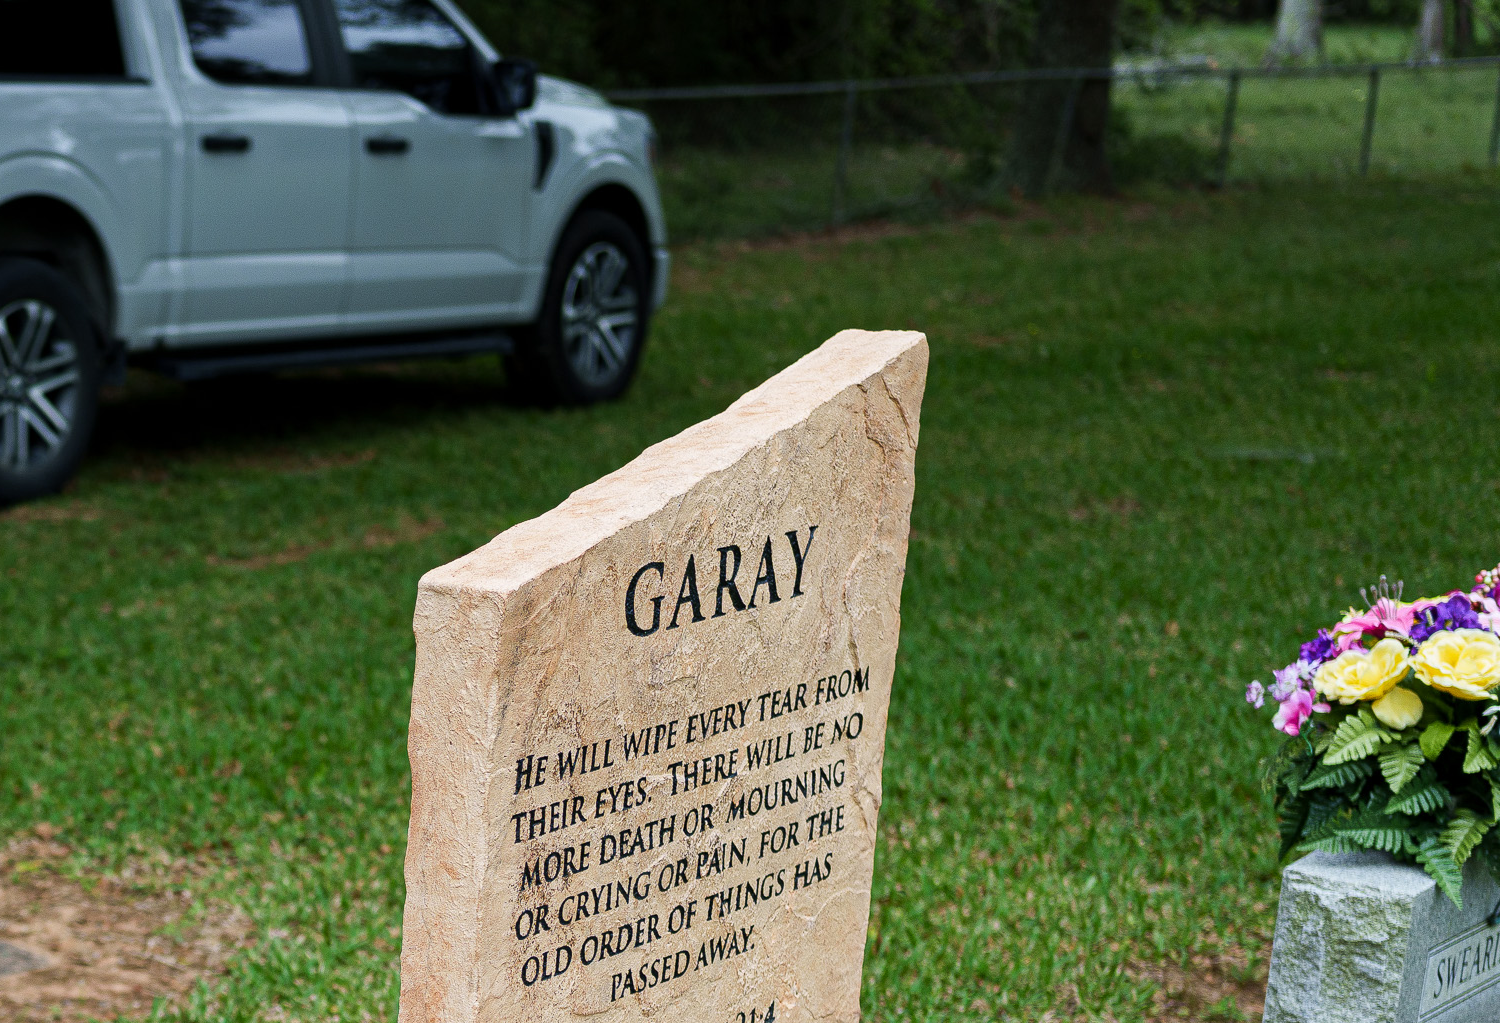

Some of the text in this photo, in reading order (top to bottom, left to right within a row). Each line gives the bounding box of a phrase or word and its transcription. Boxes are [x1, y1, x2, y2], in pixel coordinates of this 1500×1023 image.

[624, 526, 819, 637] GARAY
[510, 712, 864, 844] THEIR EYES. THERE WILL BE NO
[513, 665, 870, 796] HE WILL WIPE EVERY TEAR FROM
[514, 804, 845, 941] OR CRYING OR PAIN, FOR THE
[518, 759, 845, 892] MORE DEATH OR MOURNING
[520, 852, 833, 987] OLD ORDER OF THINGS HAS
[610, 924, 755, 1003] PASSED AWAY.
[1433, 932, 1500, 999] SWEARI
